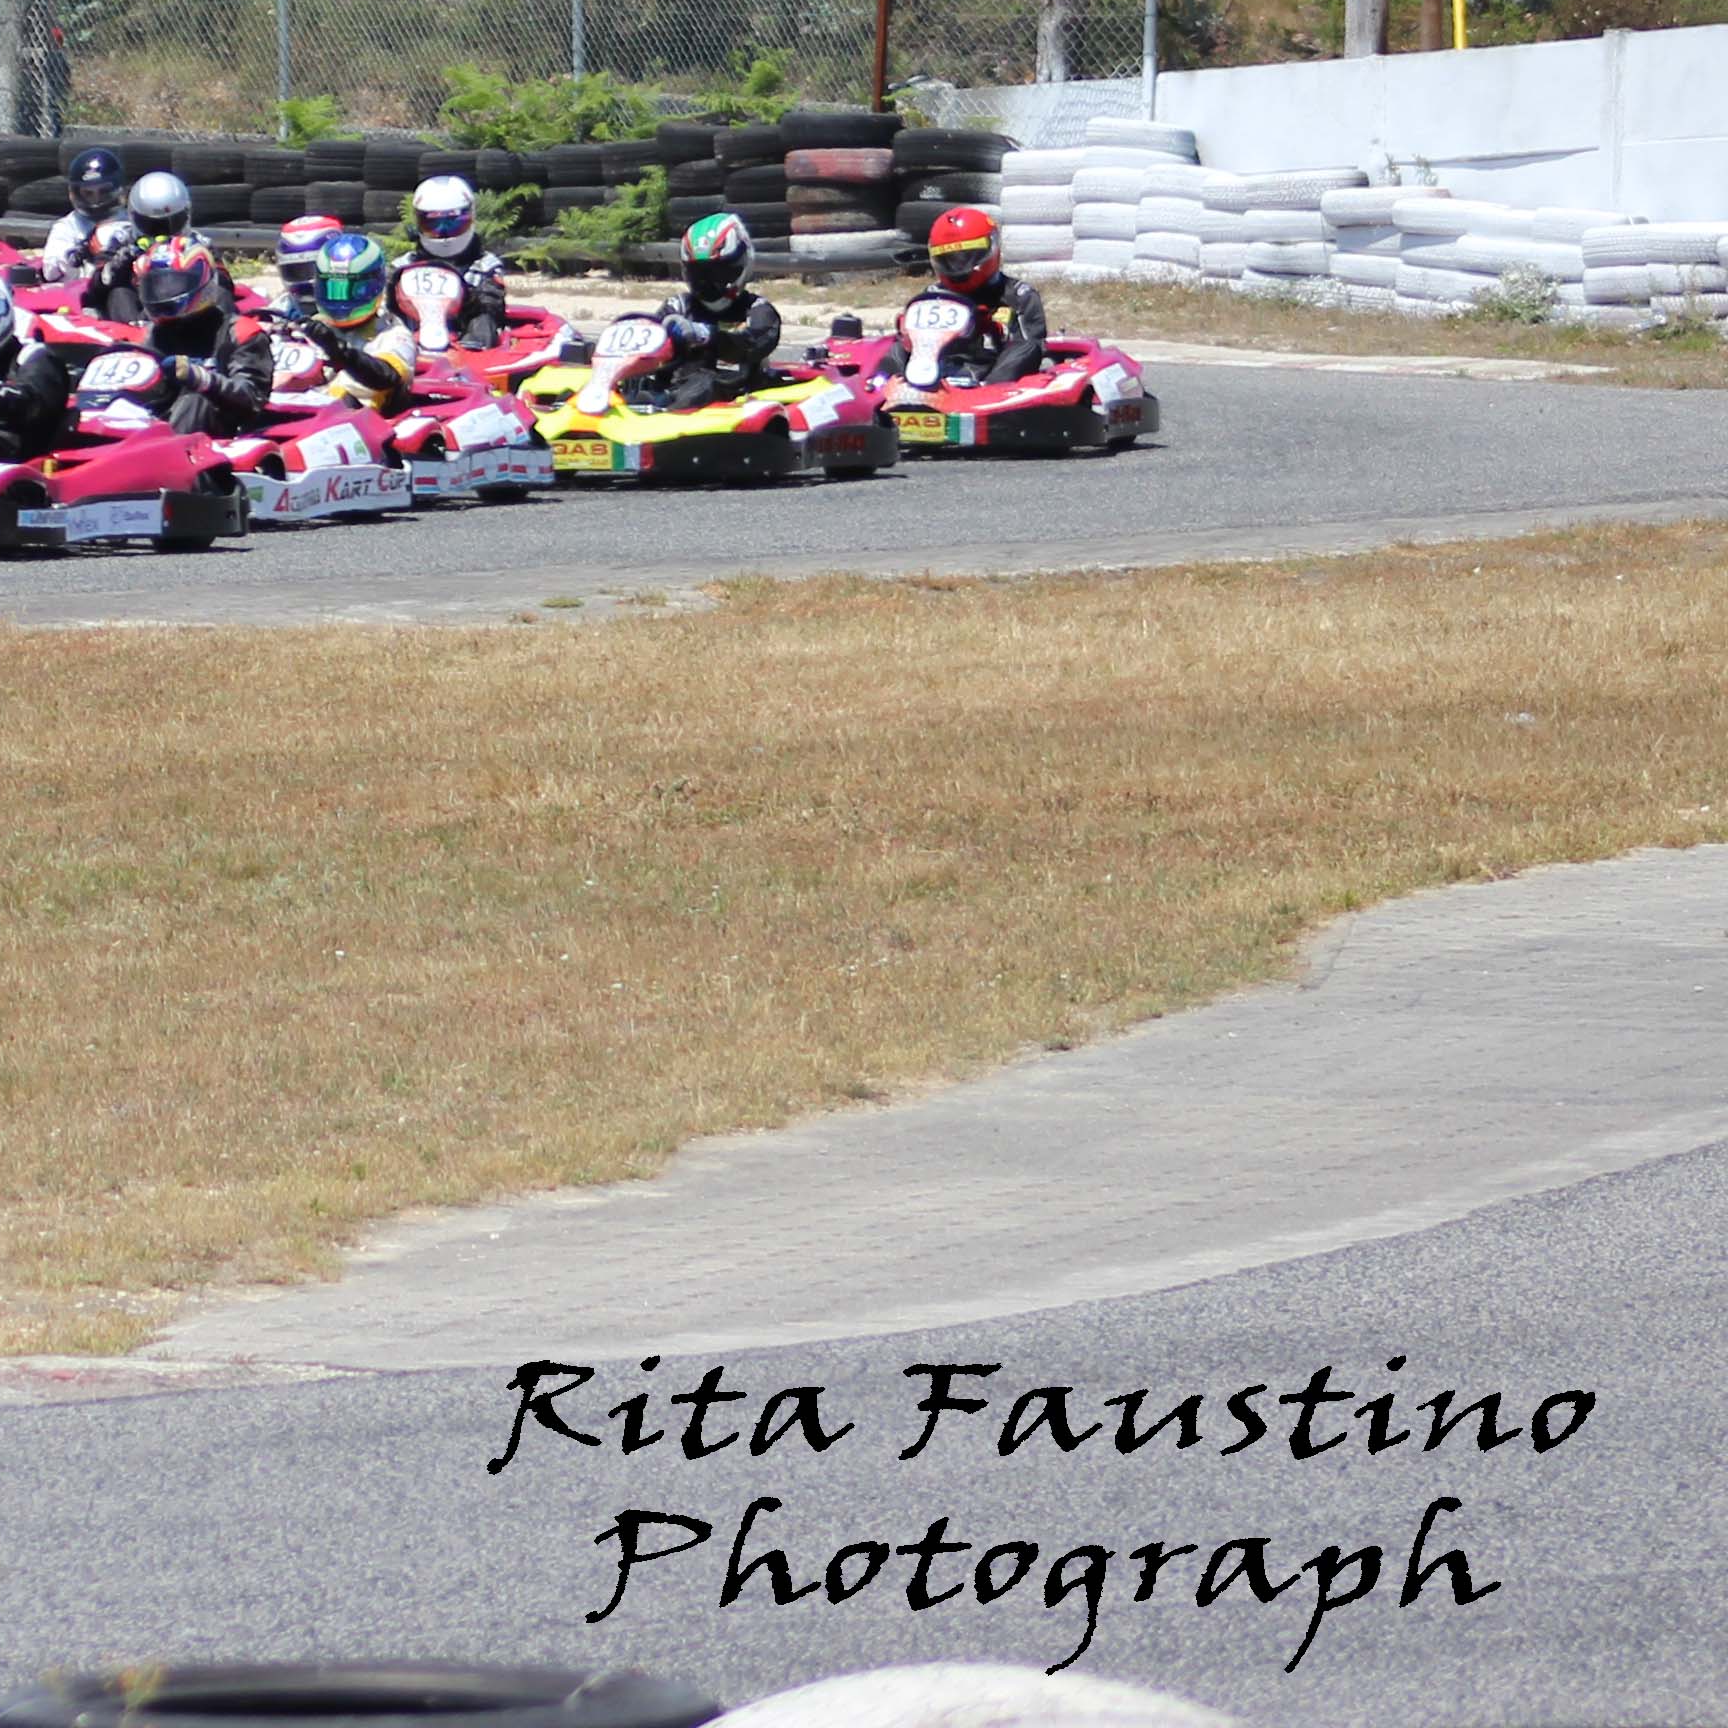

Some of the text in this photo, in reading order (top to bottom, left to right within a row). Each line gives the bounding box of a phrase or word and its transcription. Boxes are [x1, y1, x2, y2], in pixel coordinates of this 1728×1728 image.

[412, 273, 448, 295] 157
[913, 306, 958, 329] 153
[606, 326, 651, 353] 103
[90, 359, 141, 385] 149
[325, 474, 372, 503] KART
